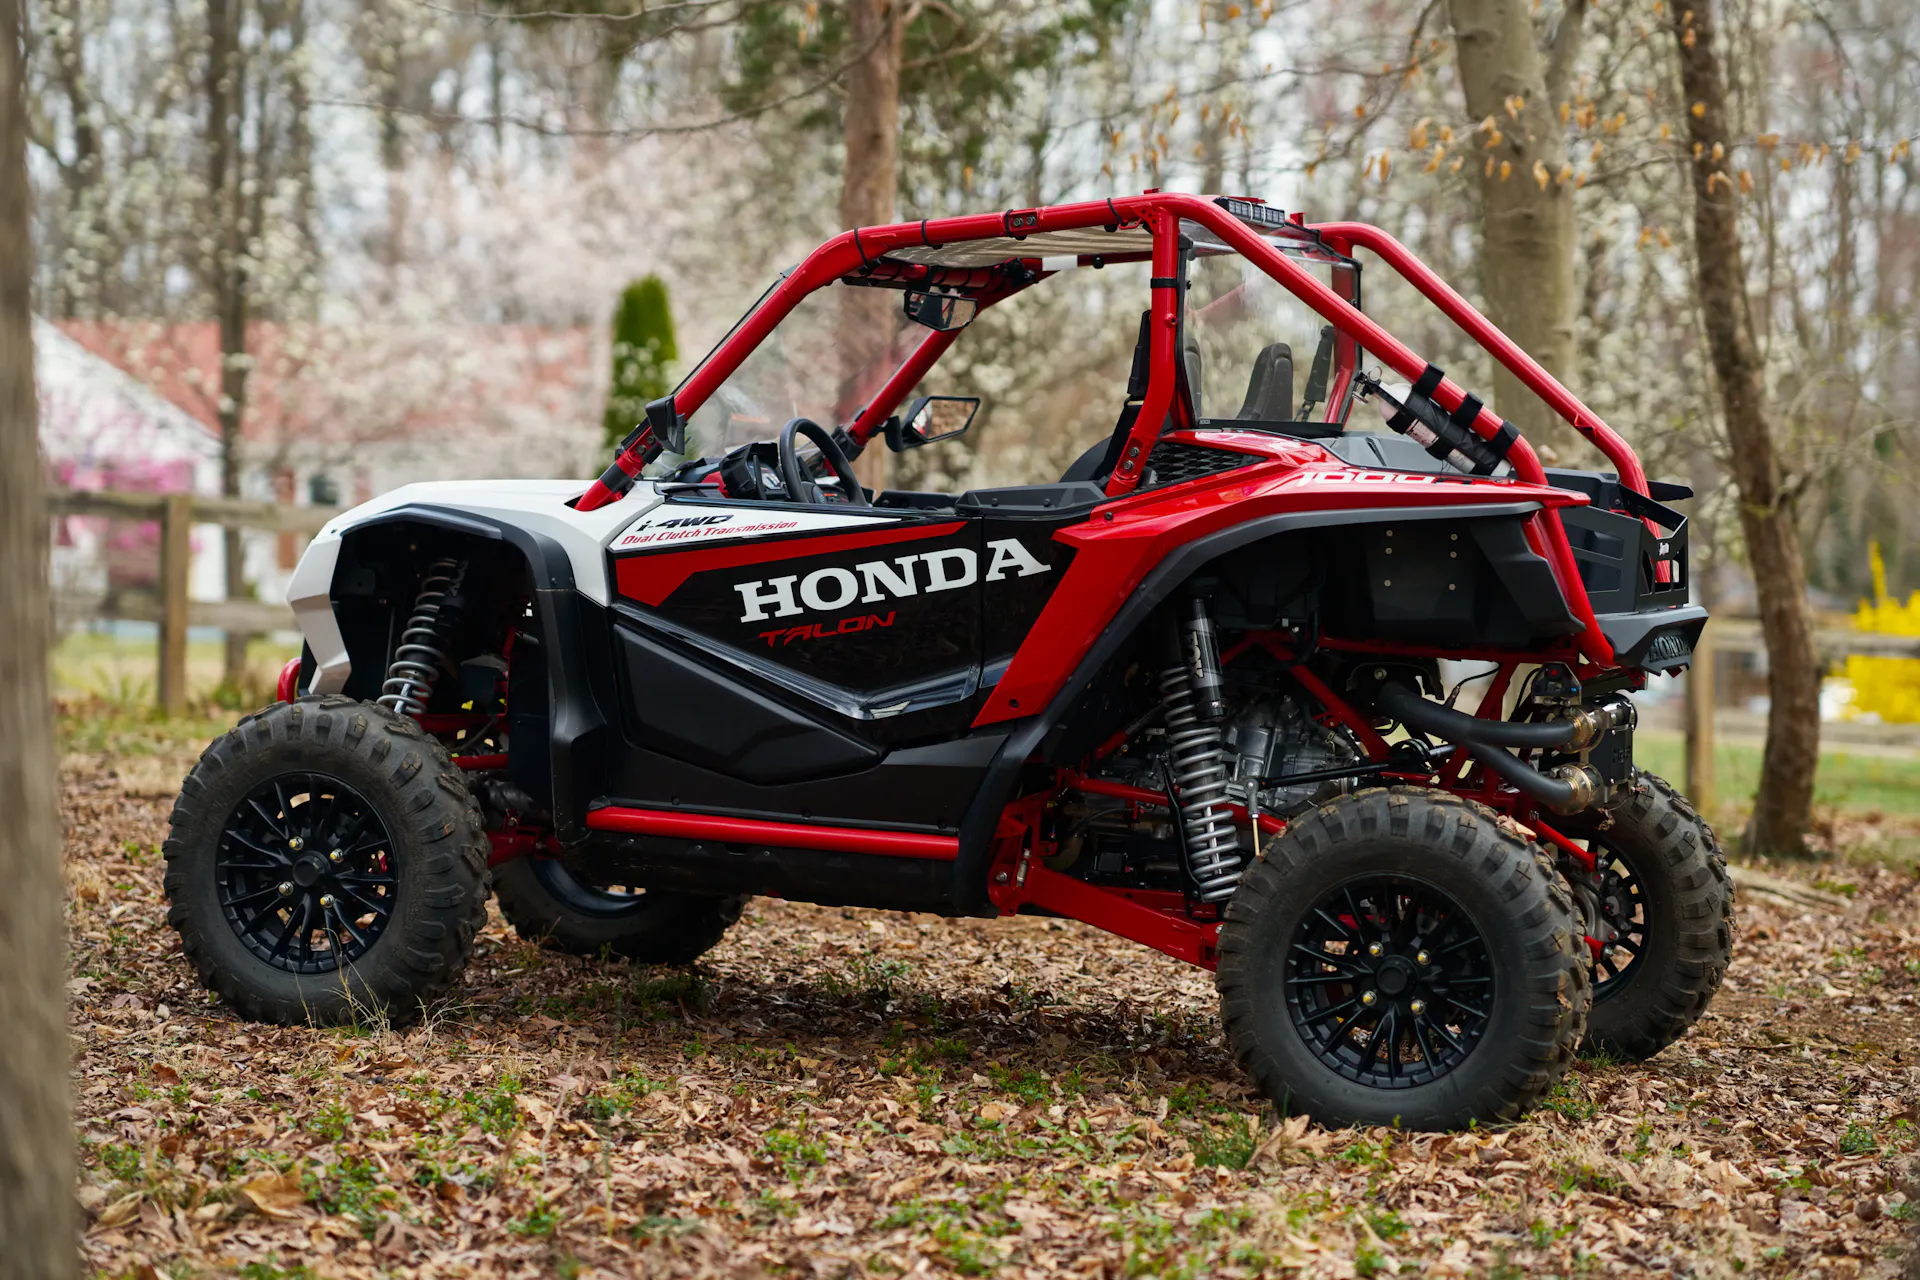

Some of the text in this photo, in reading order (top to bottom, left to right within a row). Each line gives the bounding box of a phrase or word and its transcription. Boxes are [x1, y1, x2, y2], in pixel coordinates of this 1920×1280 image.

[621, 520, 798, 546] Dual Clutch Transmission
[636, 514, 735, 532] i-4WD
[733, 537, 1052, 624] HONDA
[758, 611, 896, 648] TALON
